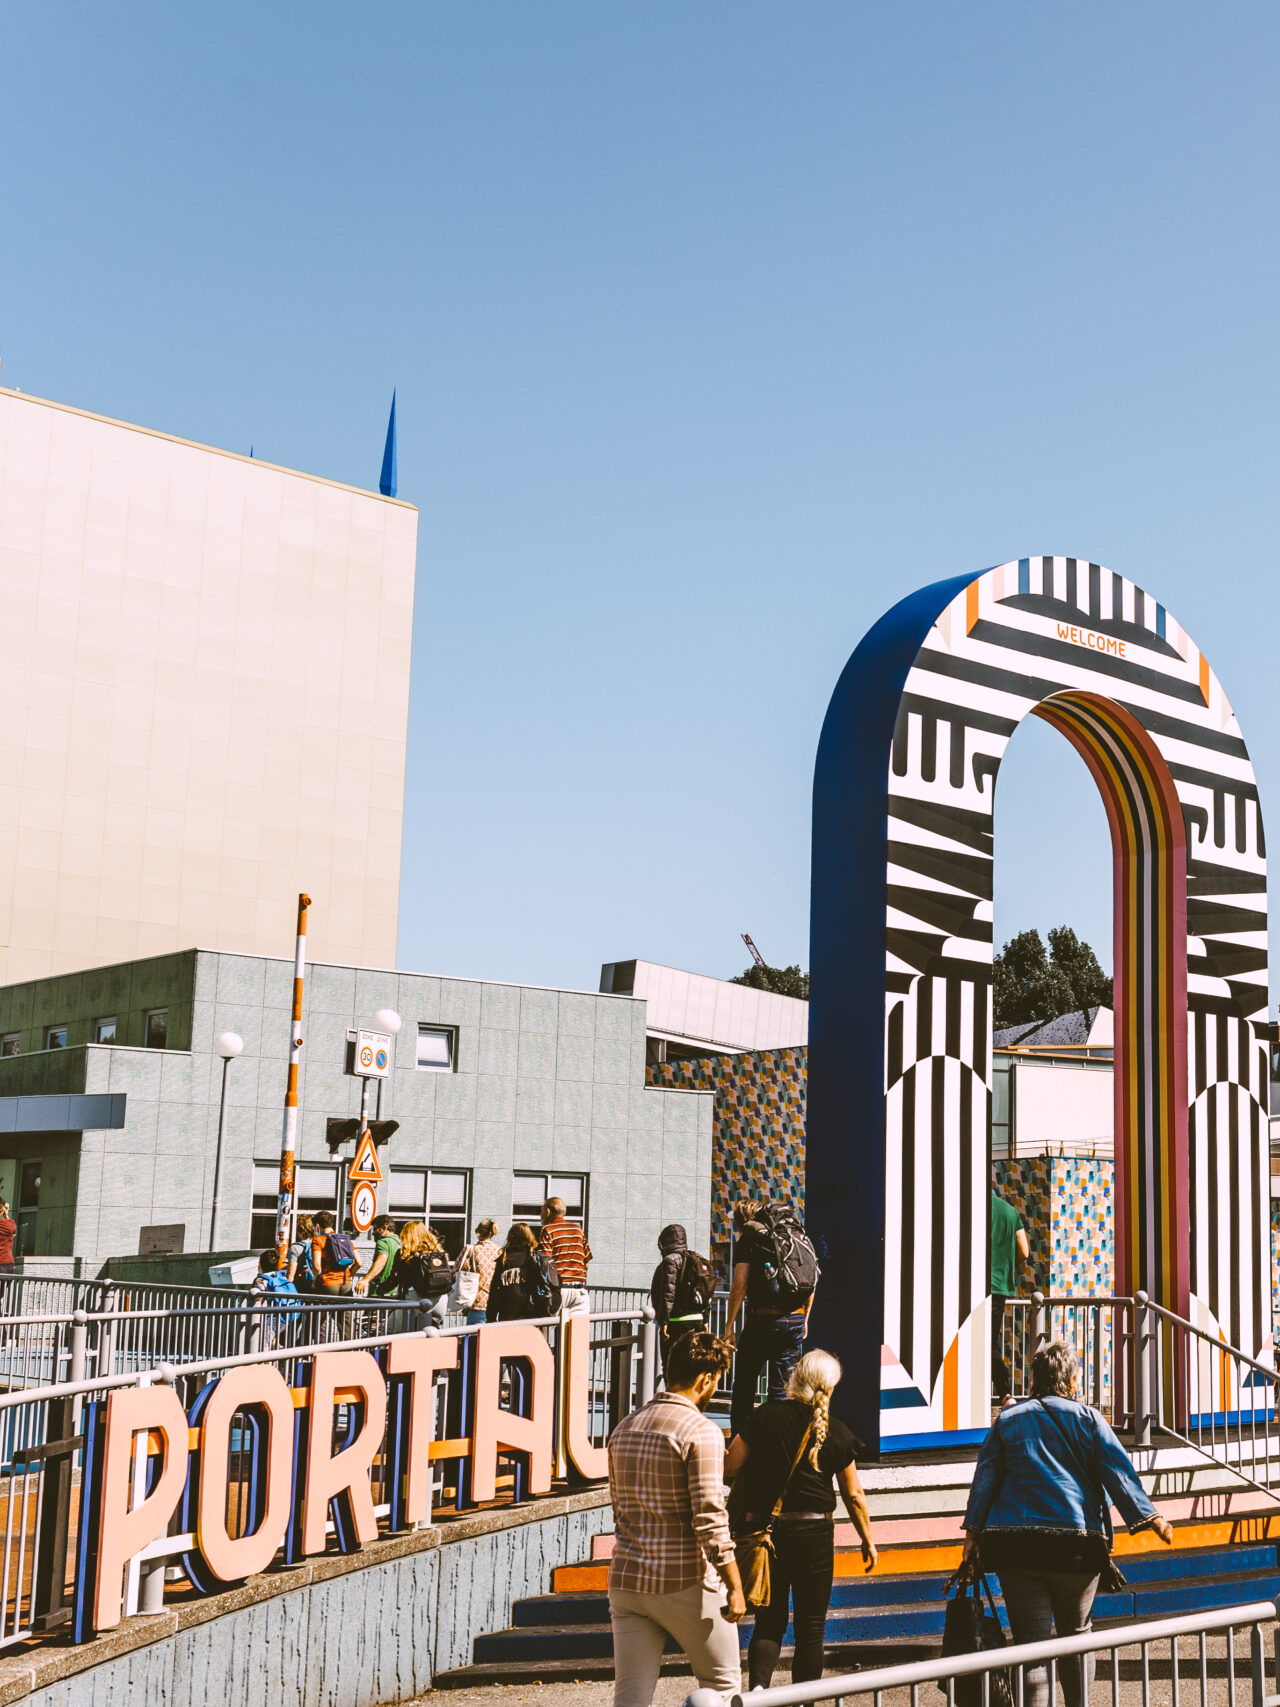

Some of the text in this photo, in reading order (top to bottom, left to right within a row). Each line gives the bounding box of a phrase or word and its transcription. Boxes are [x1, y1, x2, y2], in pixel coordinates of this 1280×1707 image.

[1057, 623, 1126, 658] WELCOME
[362, 1052, 371, 1062] 30
[92, 1316, 609, 1632] PORTAL
